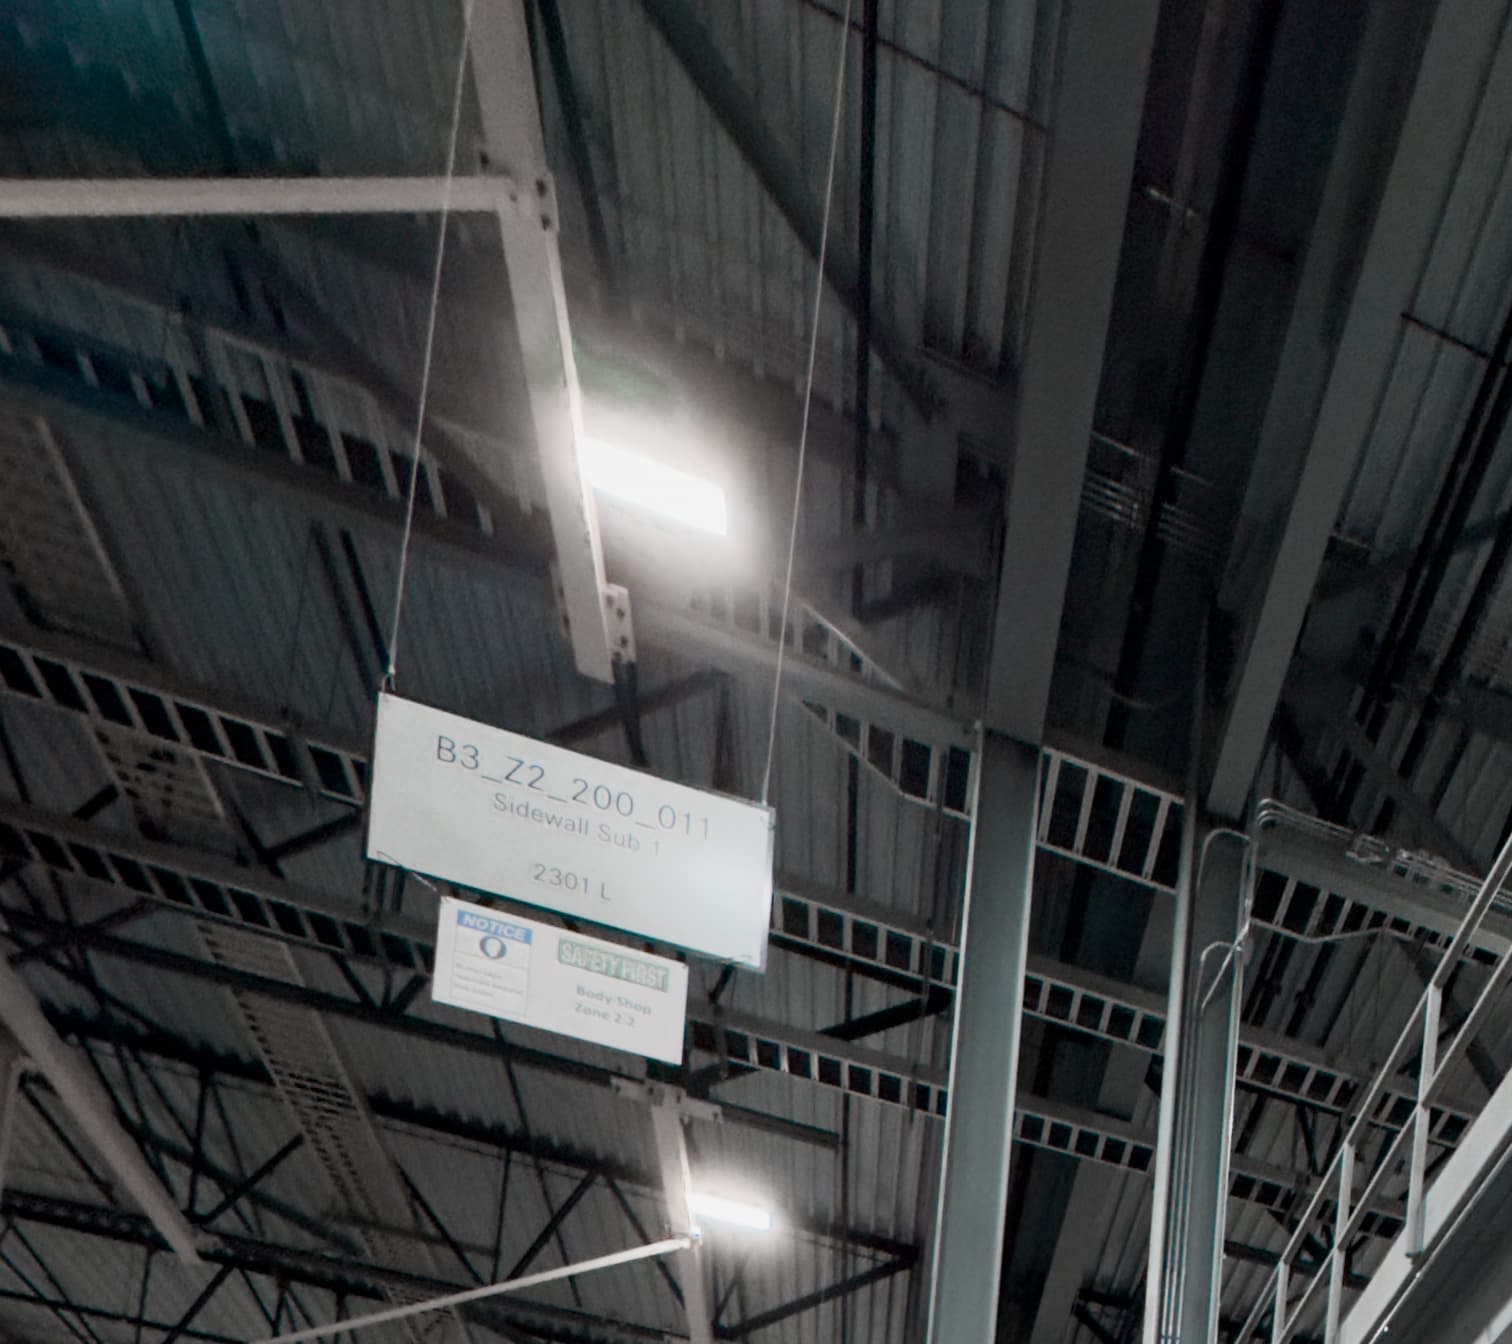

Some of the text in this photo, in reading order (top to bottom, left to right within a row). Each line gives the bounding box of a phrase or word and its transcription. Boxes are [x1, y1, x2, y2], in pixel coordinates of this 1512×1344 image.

[436, 734, 711, 841] B3_Z2_200_011
[493, 792, 589, 836] Sidewall
[598, 823, 641, 852] Sub
[533, 862, 612, 902] 2301 L
[463, 912, 526, 941] NOTICE
[561, 941, 667, 991] SAFETY FIRST
[575, 1002, 610, 1021] Zone
[576, 984, 652, 1016] Body Shop
